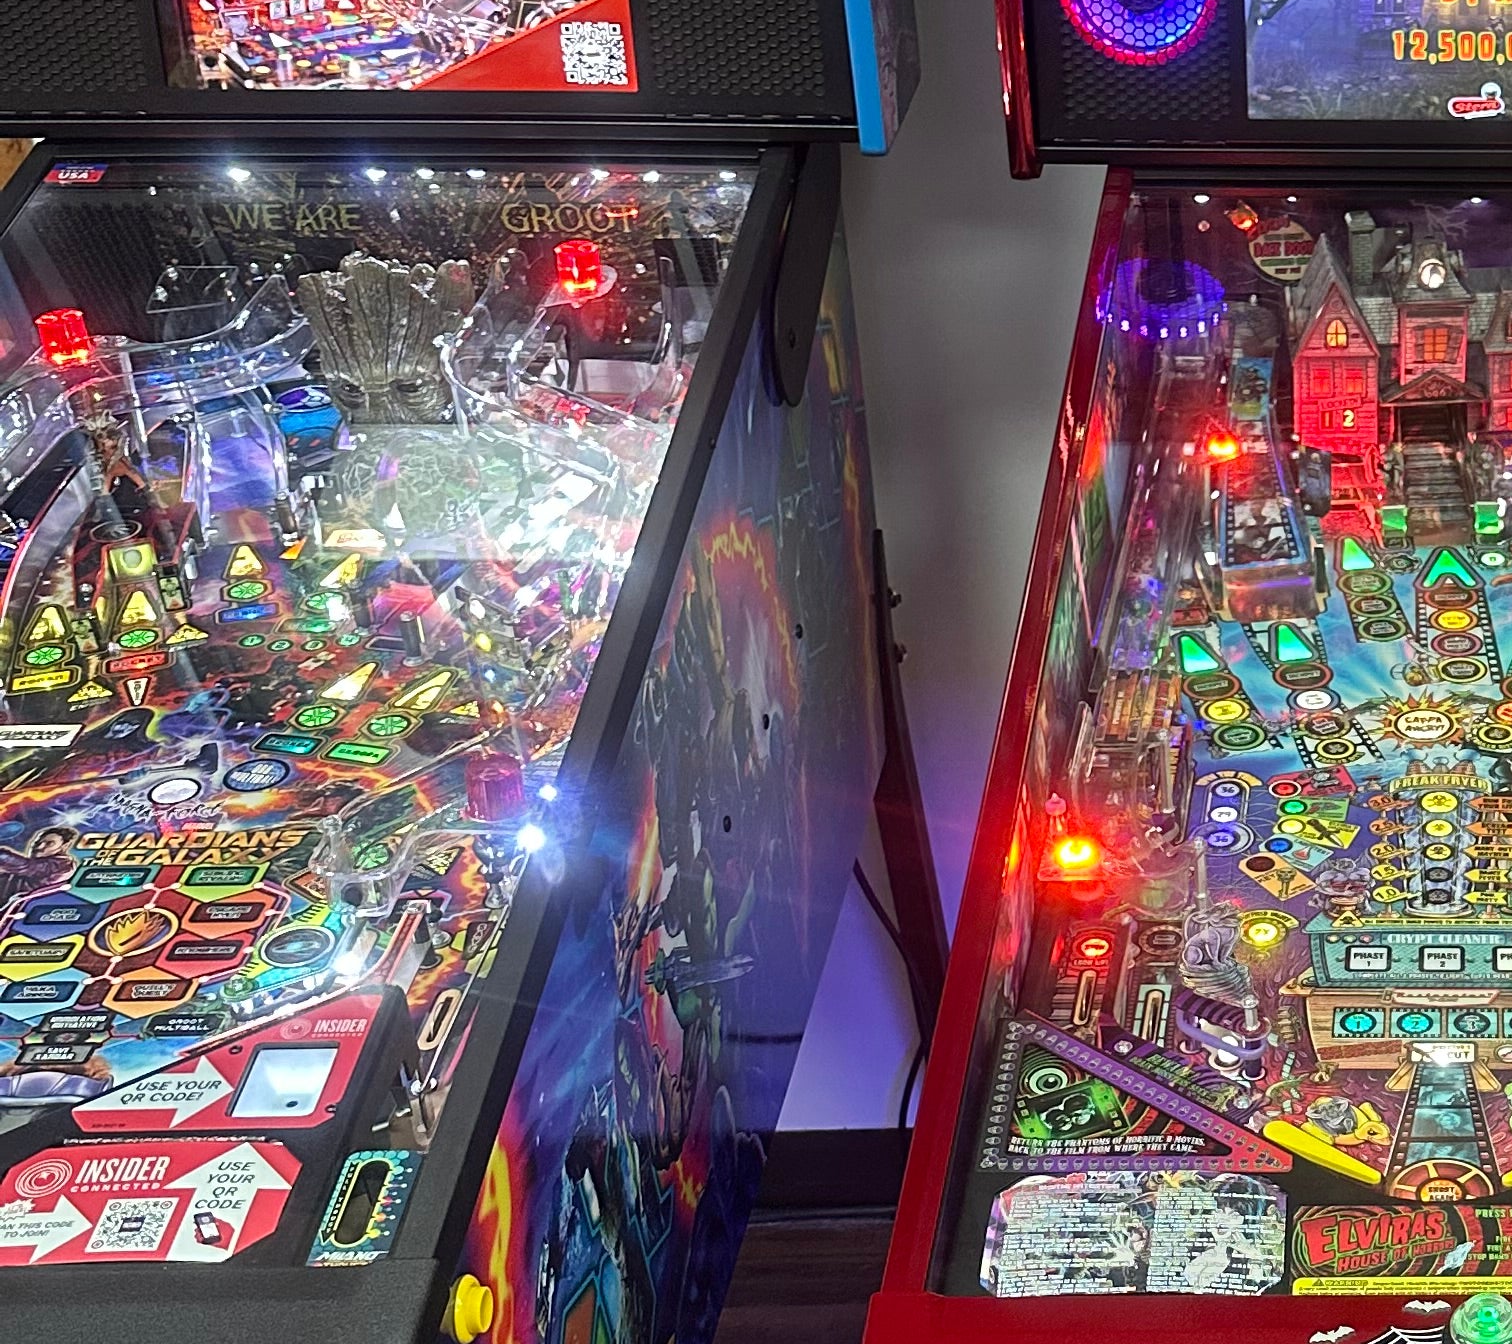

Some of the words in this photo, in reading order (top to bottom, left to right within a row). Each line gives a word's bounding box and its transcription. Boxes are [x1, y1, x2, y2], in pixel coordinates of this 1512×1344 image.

[57, 170, 89, 181] USA
[224, 203, 284, 231] WE
[297, 203, 361, 231] ARE
[502, 203, 635, 233] GROOT
[1342, 409, 1355, 427] 2
[77, 831, 310, 849] GUARDIANS
[99, 849, 119, 858] OF
[115, 847, 300, 866] GALAXY
[82, 857, 114, 867] THE
[1387, 933, 1433, 945] CRYPT
[1439, 933, 1500, 945] CLEANER
[1353, 952, 1384, 960] PHASE
[1427, 952, 1458, 960] PHASE
[313, 1019, 368, 1034] INSIDER
[1448, 1051, 1470, 1060] CUT
[136, 1080, 172, 1092] USE
[176, 1079, 223, 1091] YOUR
[120, 1092, 149, 1104] QR
[151, 1091, 204, 1102] CODE!
[1065, 1137, 1110, 1146] PHANTOMS
[1112, 1136, 1124, 1144] OF
[1008, 1146, 1029, 1154] BACK
[1114, 1145, 1143, 1153] WHERE
[75, 1157, 171, 1183] INSIDER
[218, 1161, 256, 1171] USE
[206, 1174, 256, 1184] YOUR
[70, 1182, 161, 1193] CONNECTED
[212, 1186, 239, 1197] QR
[194, 1199, 246, 1210] CODE
[1475, 1209, 1505, 1217] PRESS
[44, 1220, 73, 1228] CODE
[1338, 1253, 1388, 1274] HOUSE
[1392, 1247, 1408, 1261] OF
